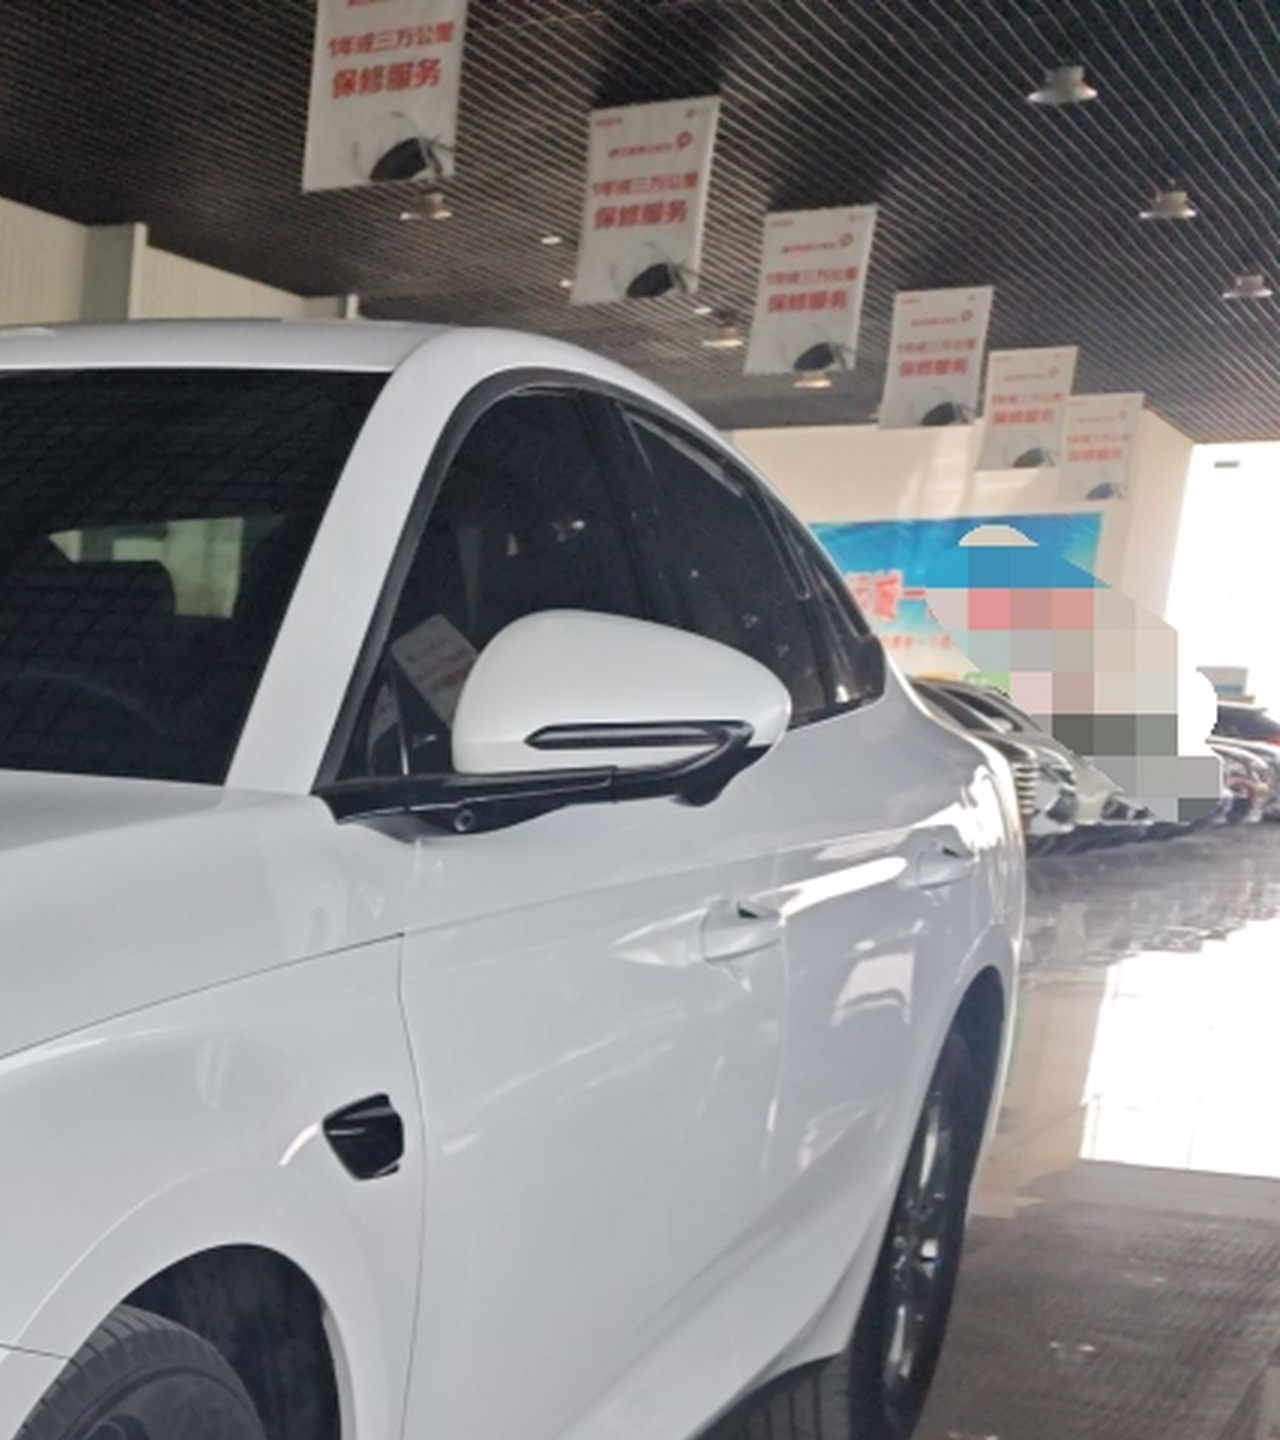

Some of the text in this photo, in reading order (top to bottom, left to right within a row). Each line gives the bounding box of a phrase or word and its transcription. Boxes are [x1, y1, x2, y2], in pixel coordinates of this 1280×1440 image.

[332, 57, 441, 99] 保修服务
[594, 200, 687, 231] 保修服务
